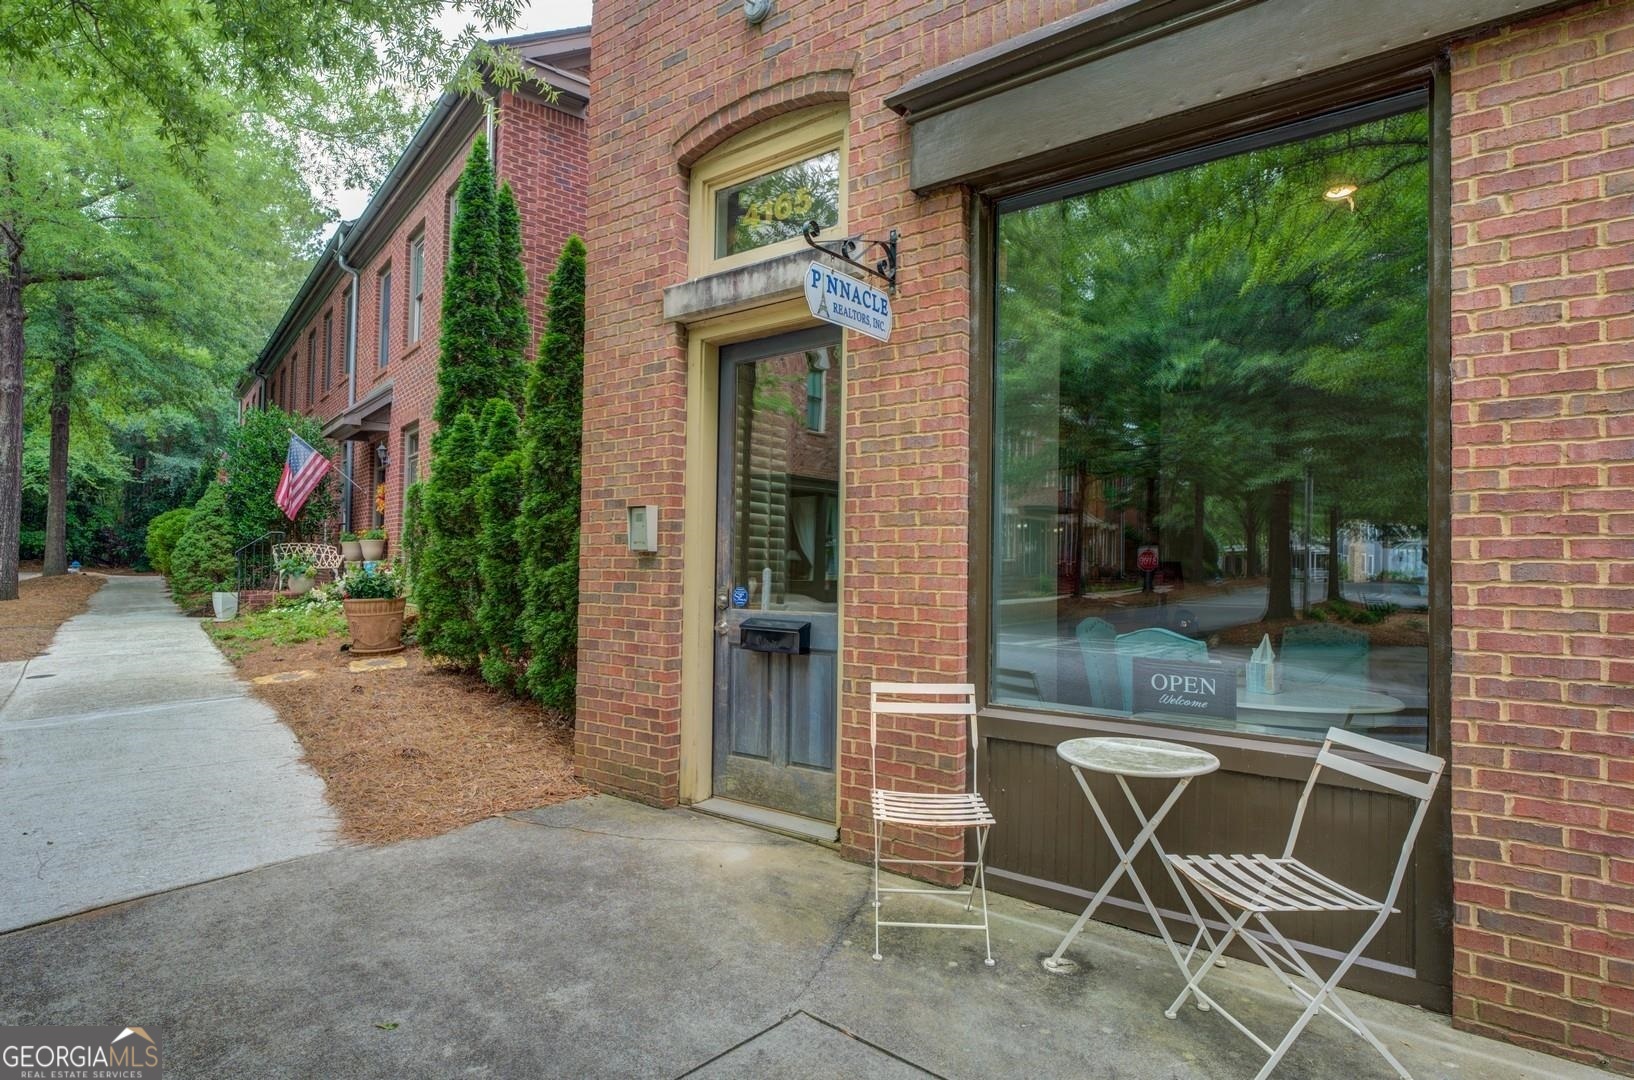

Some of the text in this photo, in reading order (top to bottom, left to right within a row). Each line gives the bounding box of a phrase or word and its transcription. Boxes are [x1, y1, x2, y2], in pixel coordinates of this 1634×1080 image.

[742, 187, 813, 228] 4165
[832, 302, 886, 332] REALTORS, INC.
[1151, 673, 1216, 696] OPEN
[1159, 693, 1208, 709] Welcome
